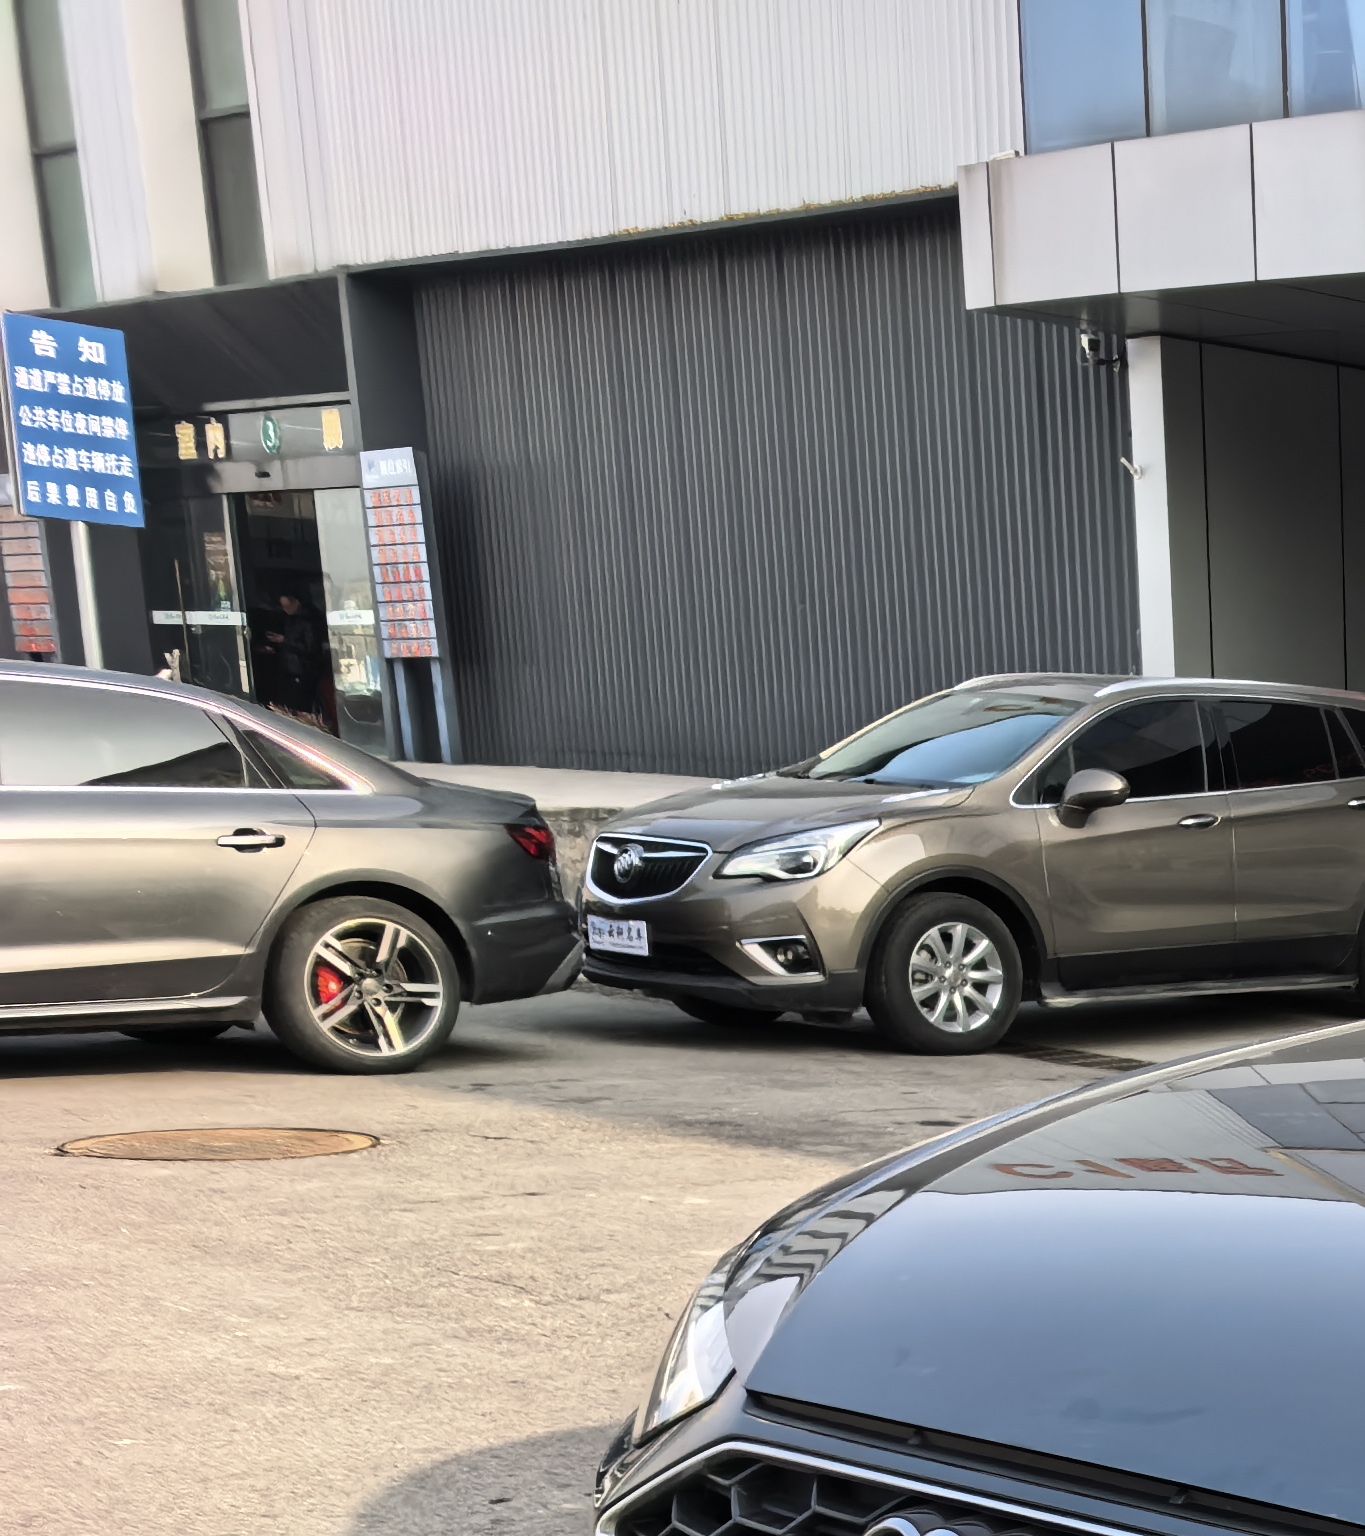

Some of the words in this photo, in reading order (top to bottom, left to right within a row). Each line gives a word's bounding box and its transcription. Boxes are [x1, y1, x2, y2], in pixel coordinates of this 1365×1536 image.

[29, 329, 107, 365] 告知
[14, 365, 127, 404] 通道严禁占道停放
[19, 405, 130, 440] 公共车位夜间禁停
[27, 480, 137, 514] 后果费用自负
